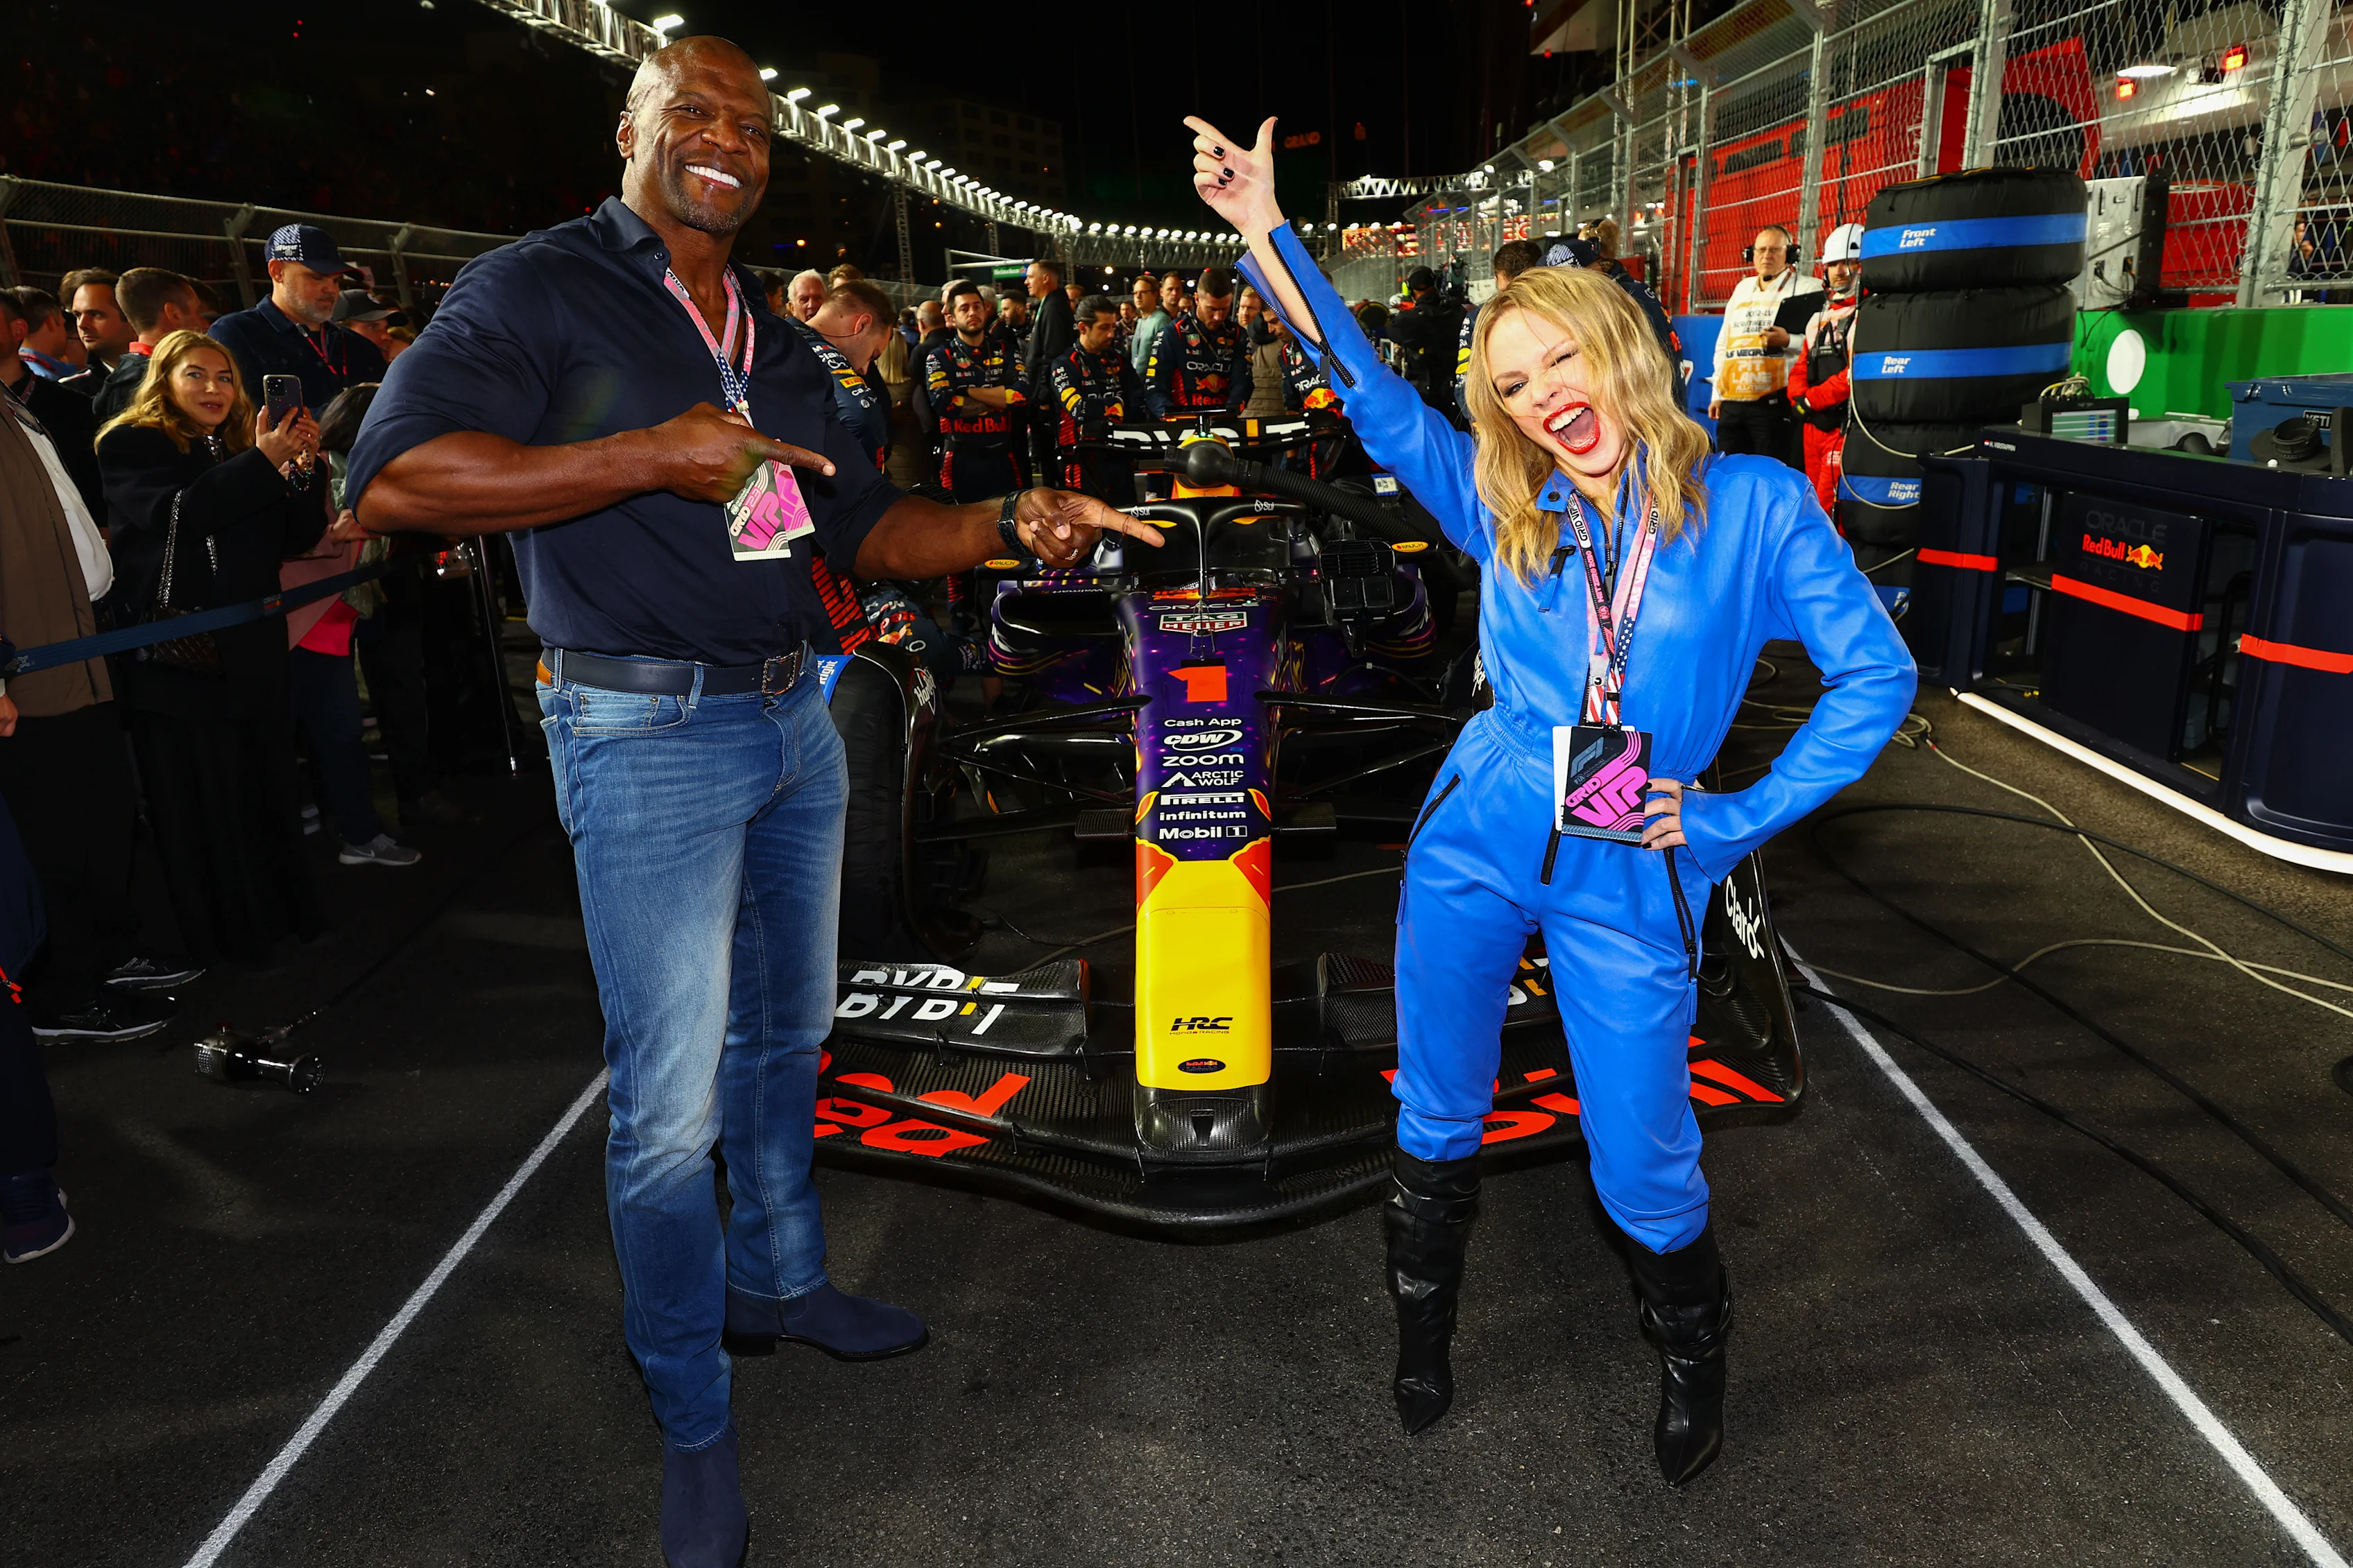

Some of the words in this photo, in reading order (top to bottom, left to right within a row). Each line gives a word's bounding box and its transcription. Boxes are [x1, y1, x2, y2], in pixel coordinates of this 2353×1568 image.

[1902, 227, 1937, 239] Front
[1899, 237, 1926, 248] Left
[1736, 359, 1765, 372] PIT
[1884, 356, 1910, 365] Rear
[1881, 364, 1906, 373] Left
[1732, 372, 1772, 384] LANE
[954, 417, 983, 433] Red
[1890, 481, 1919, 491] Rear
[1888, 490, 1920, 500] Right
[1263, 501, 1274, 511] Sui
[730, 506, 751, 537] GRID
[1649, 509, 1659, 535] GRID
[1576, 520, 1587, 542] GRID
[2082, 533, 2104, 555] Red
[2103, 539, 2125, 560] Bull
[1632, 546, 1651, 592] VEGAS
[1148, 601, 1260, 610] ORACLE
[1629, 594, 1638, 609] LAS
[1165, 621, 1244, 629] HEUER
[1167, 666, 1227, 702] 1
[1164, 718, 1204, 727] Cash
[1208, 717, 1242, 727] App
[1162, 754, 1244, 766] zoom
[1192, 770, 1244, 779] ARCTIC
[1566, 777, 1602, 807] GRID
[1571, 766, 1648, 827] VIP
[1160, 793, 1244, 805] PIRELLI
[1159, 811, 1247, 821] infinitum
[1159, 827, 1222, 839] Mobil
[1725, 875, 1765, 959] Claro
[1171, 1017, 1233, 1031] HRC
